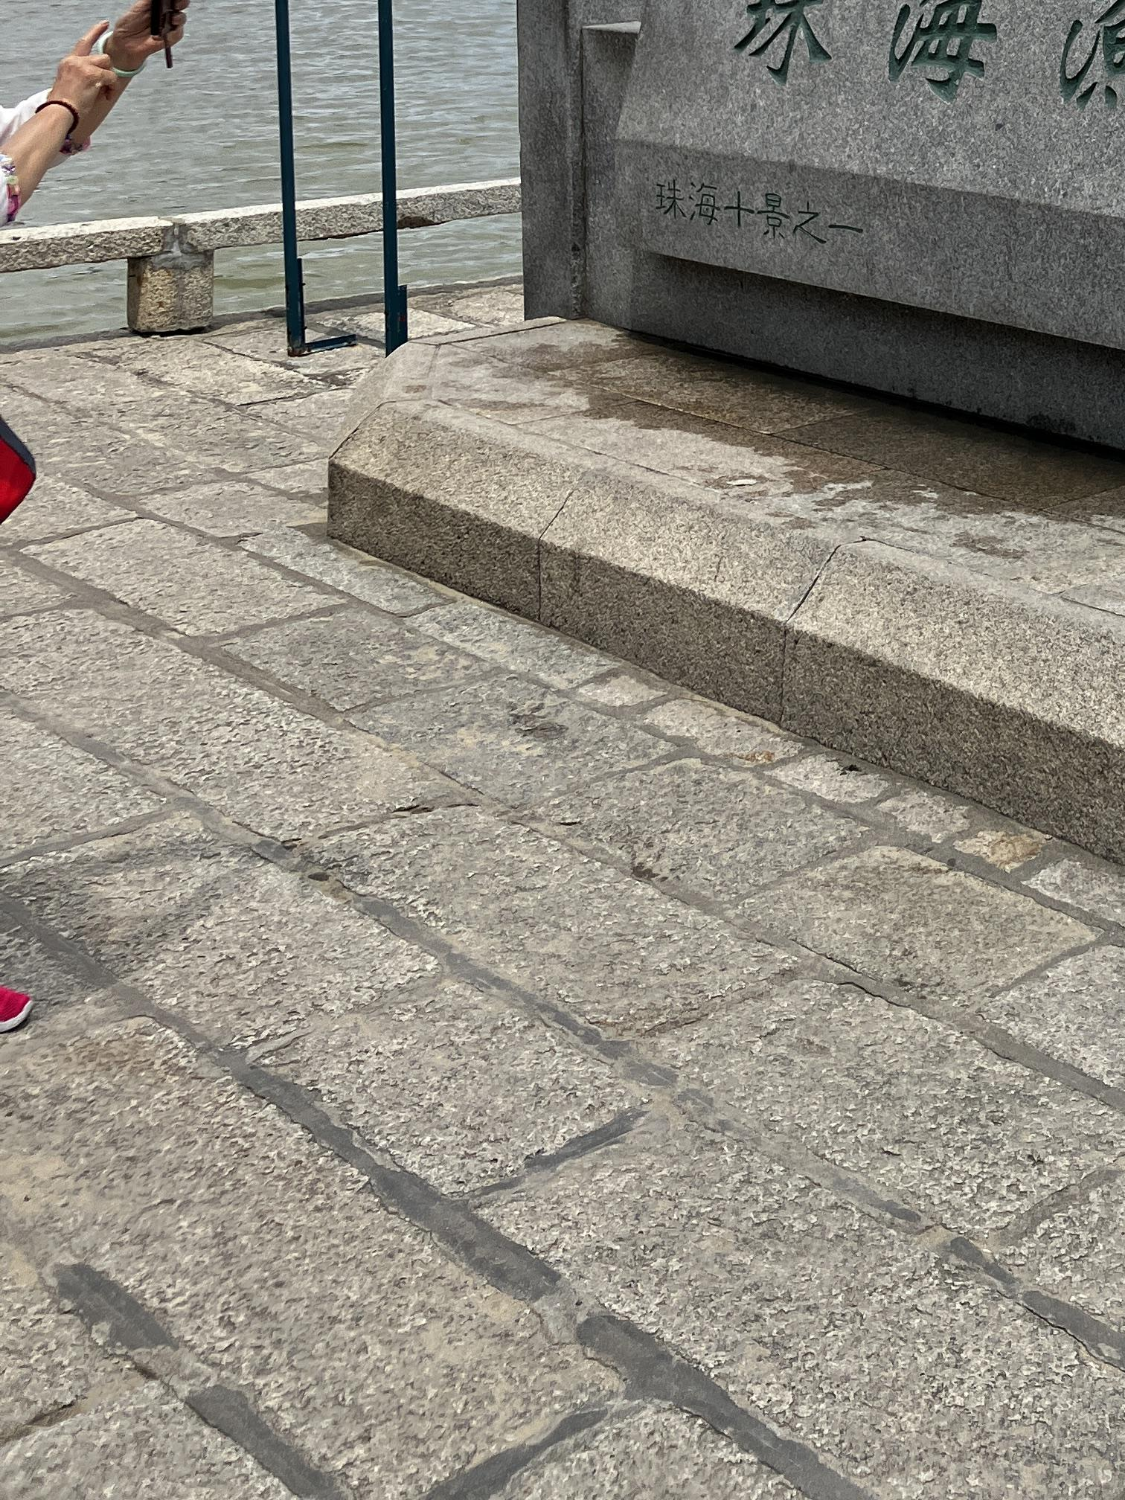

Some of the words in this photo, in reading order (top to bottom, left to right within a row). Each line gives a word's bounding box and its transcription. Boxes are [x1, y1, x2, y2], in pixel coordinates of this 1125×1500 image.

[656, 179, 863, 244] 珠海十景之一
